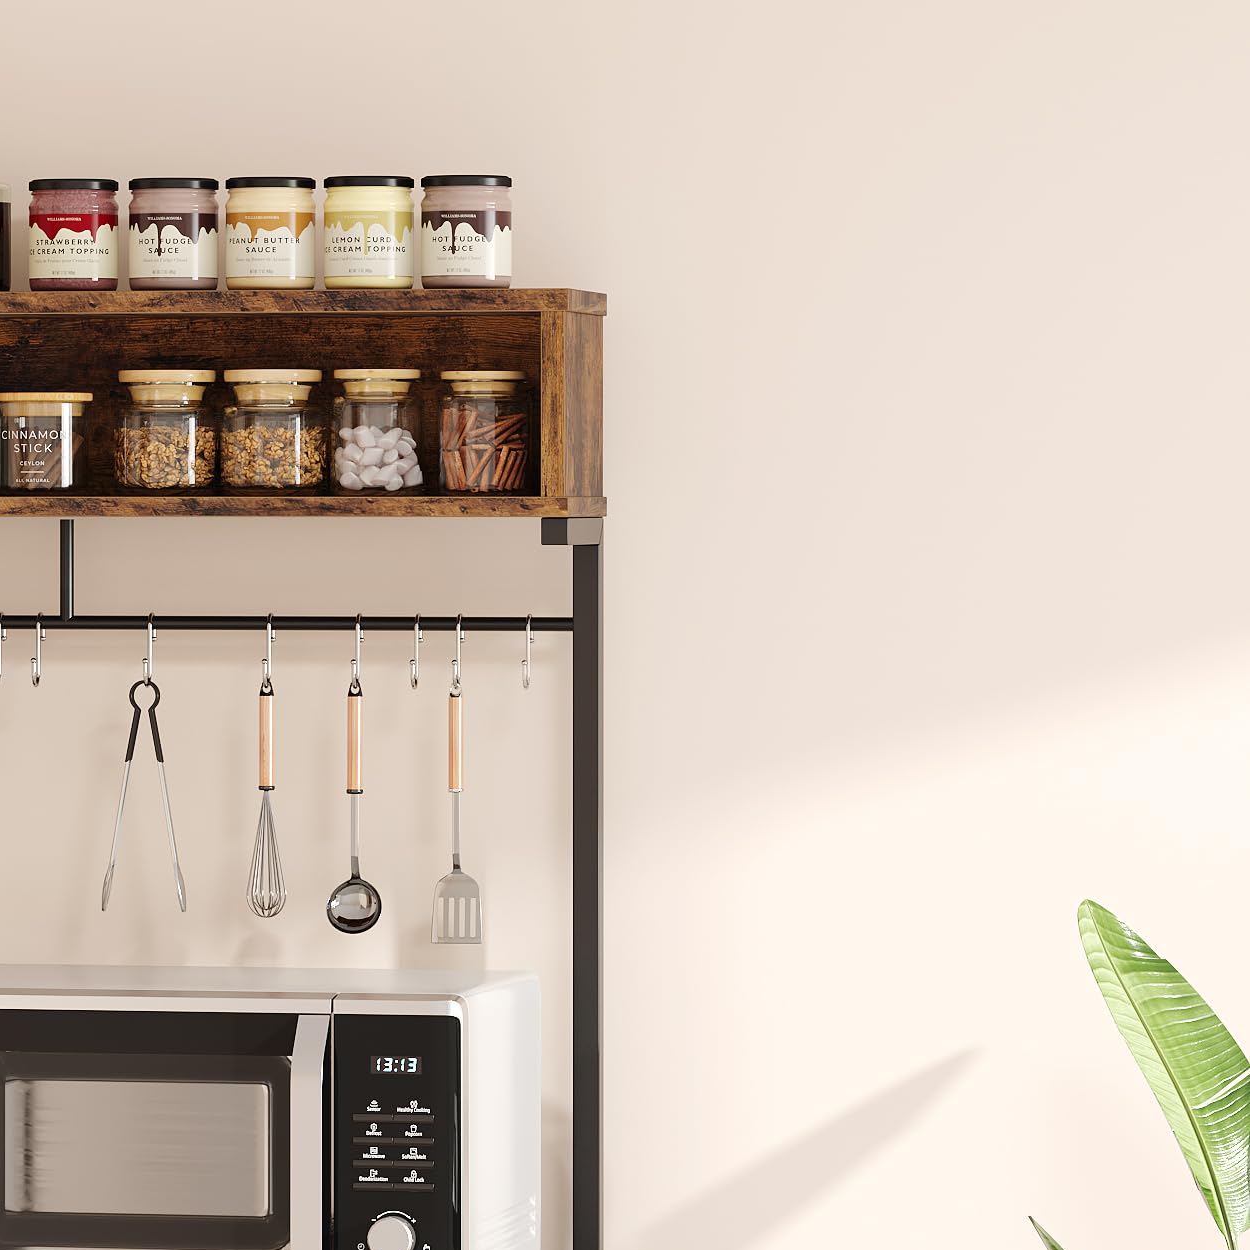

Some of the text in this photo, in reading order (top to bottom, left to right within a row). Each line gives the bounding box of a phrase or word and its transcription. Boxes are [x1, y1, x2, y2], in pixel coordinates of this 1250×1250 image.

[36, 238, 96, 246] STRAWBERRY
[229, 237, 259, 245] PEANUT
[331, 236, 361, 244] LEMON
[432, 235, 449, 243] HOT
[245, 246, 277, 254] SAUCE
[366, 245, 406, 253] TOPPING
[1, 430, 67, 440] CINNAMON
[13, 443, 53, 453] STICK
[376, 1057, 418, 1073] 13:13
